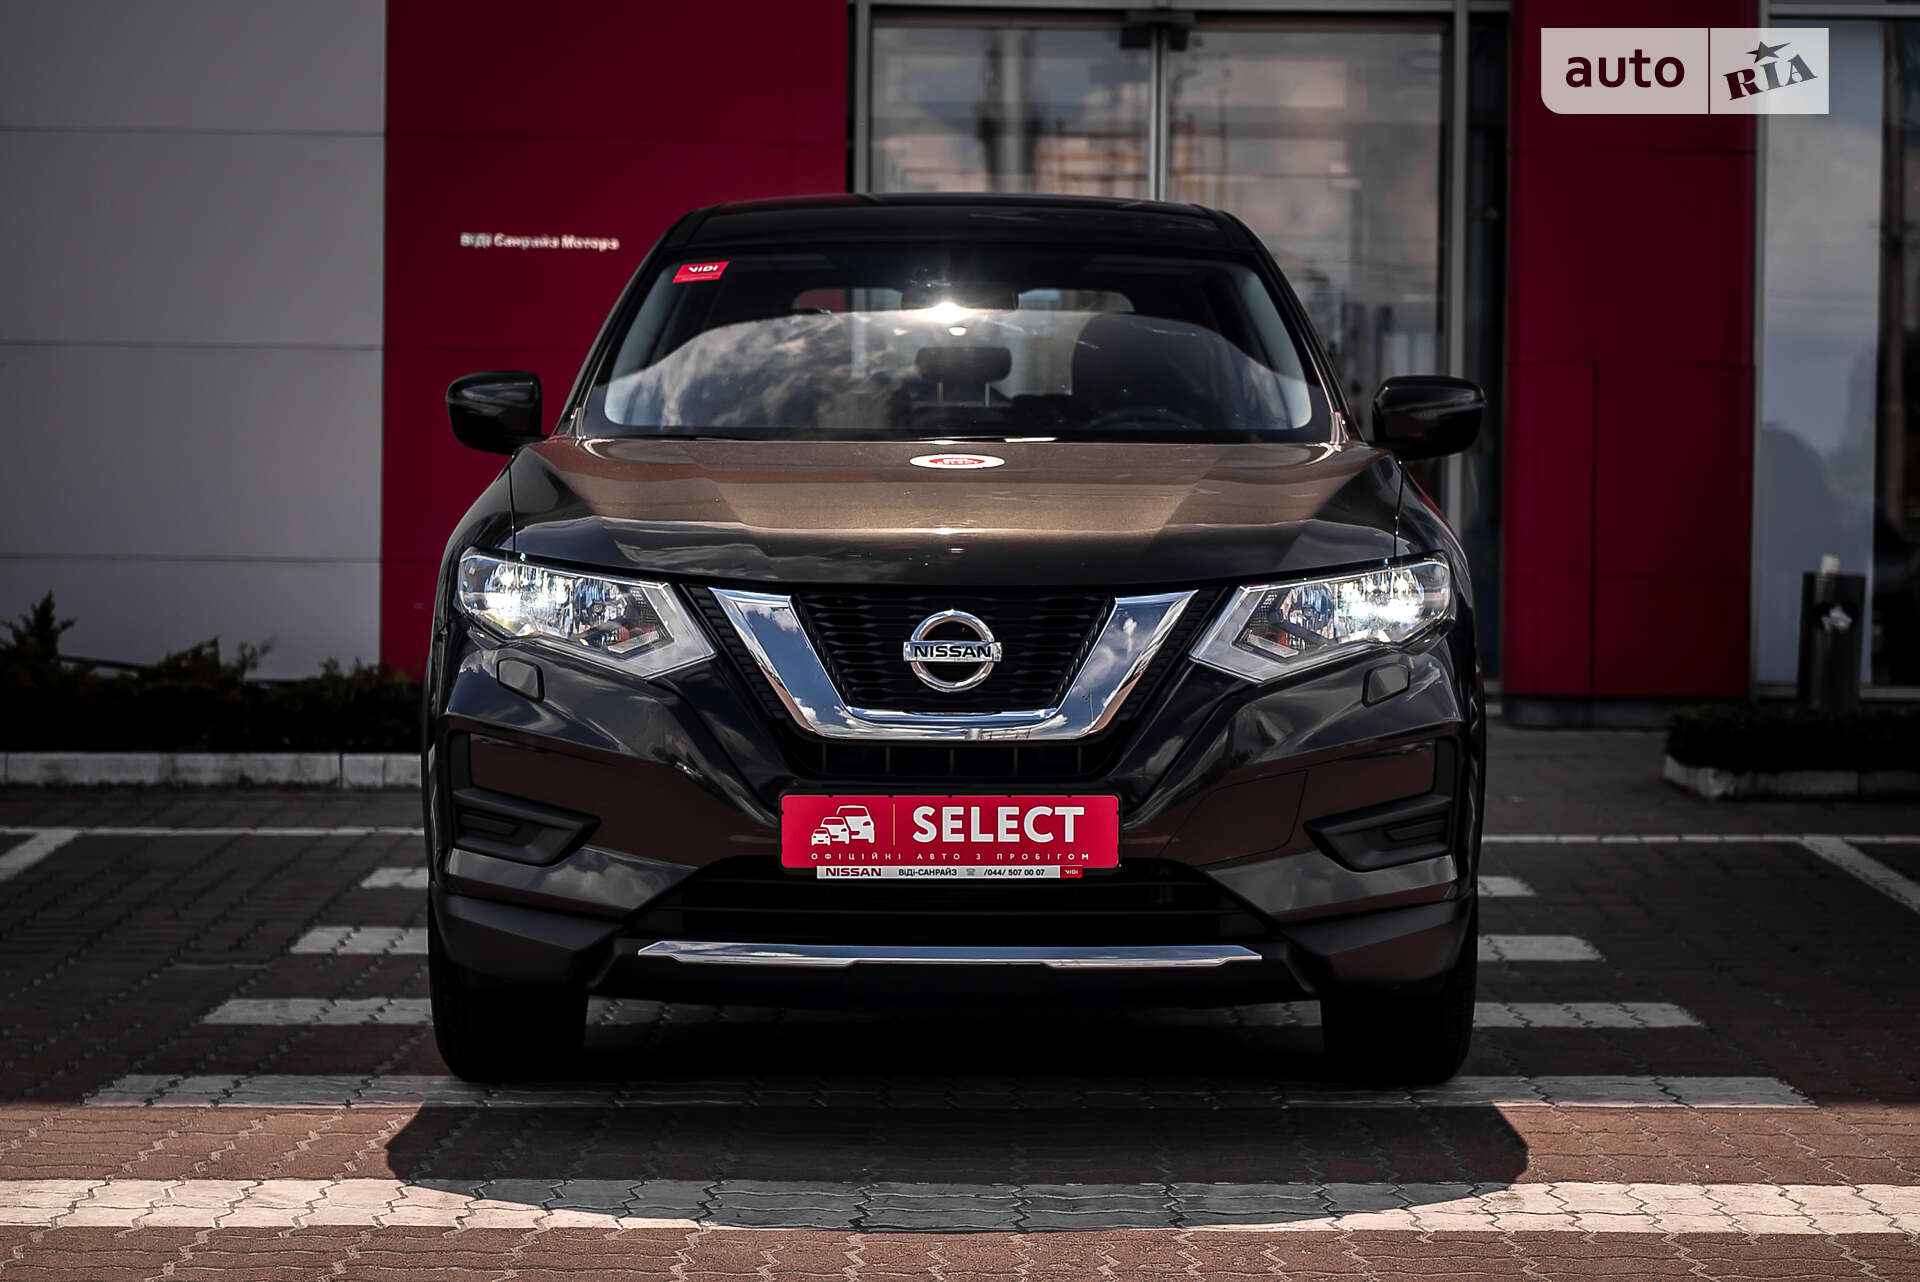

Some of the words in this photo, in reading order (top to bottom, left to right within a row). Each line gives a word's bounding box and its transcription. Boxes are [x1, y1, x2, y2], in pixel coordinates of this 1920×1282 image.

[689, 265, 718, 273] VIDI
[914, 645, 992, 658] NISSAN
[912, 806, 1085, 843] SELECT
[811, 852, 901, 861] ОФІЦІЙНІ
[825, 867, 882, 877] NISSAN
[983, 868, 1006, 877] /044/
[1008, 868, 1022, 876] 507
[1024, 868, 1034, 876] 00
[1036, 868, 1045, 876] 07
